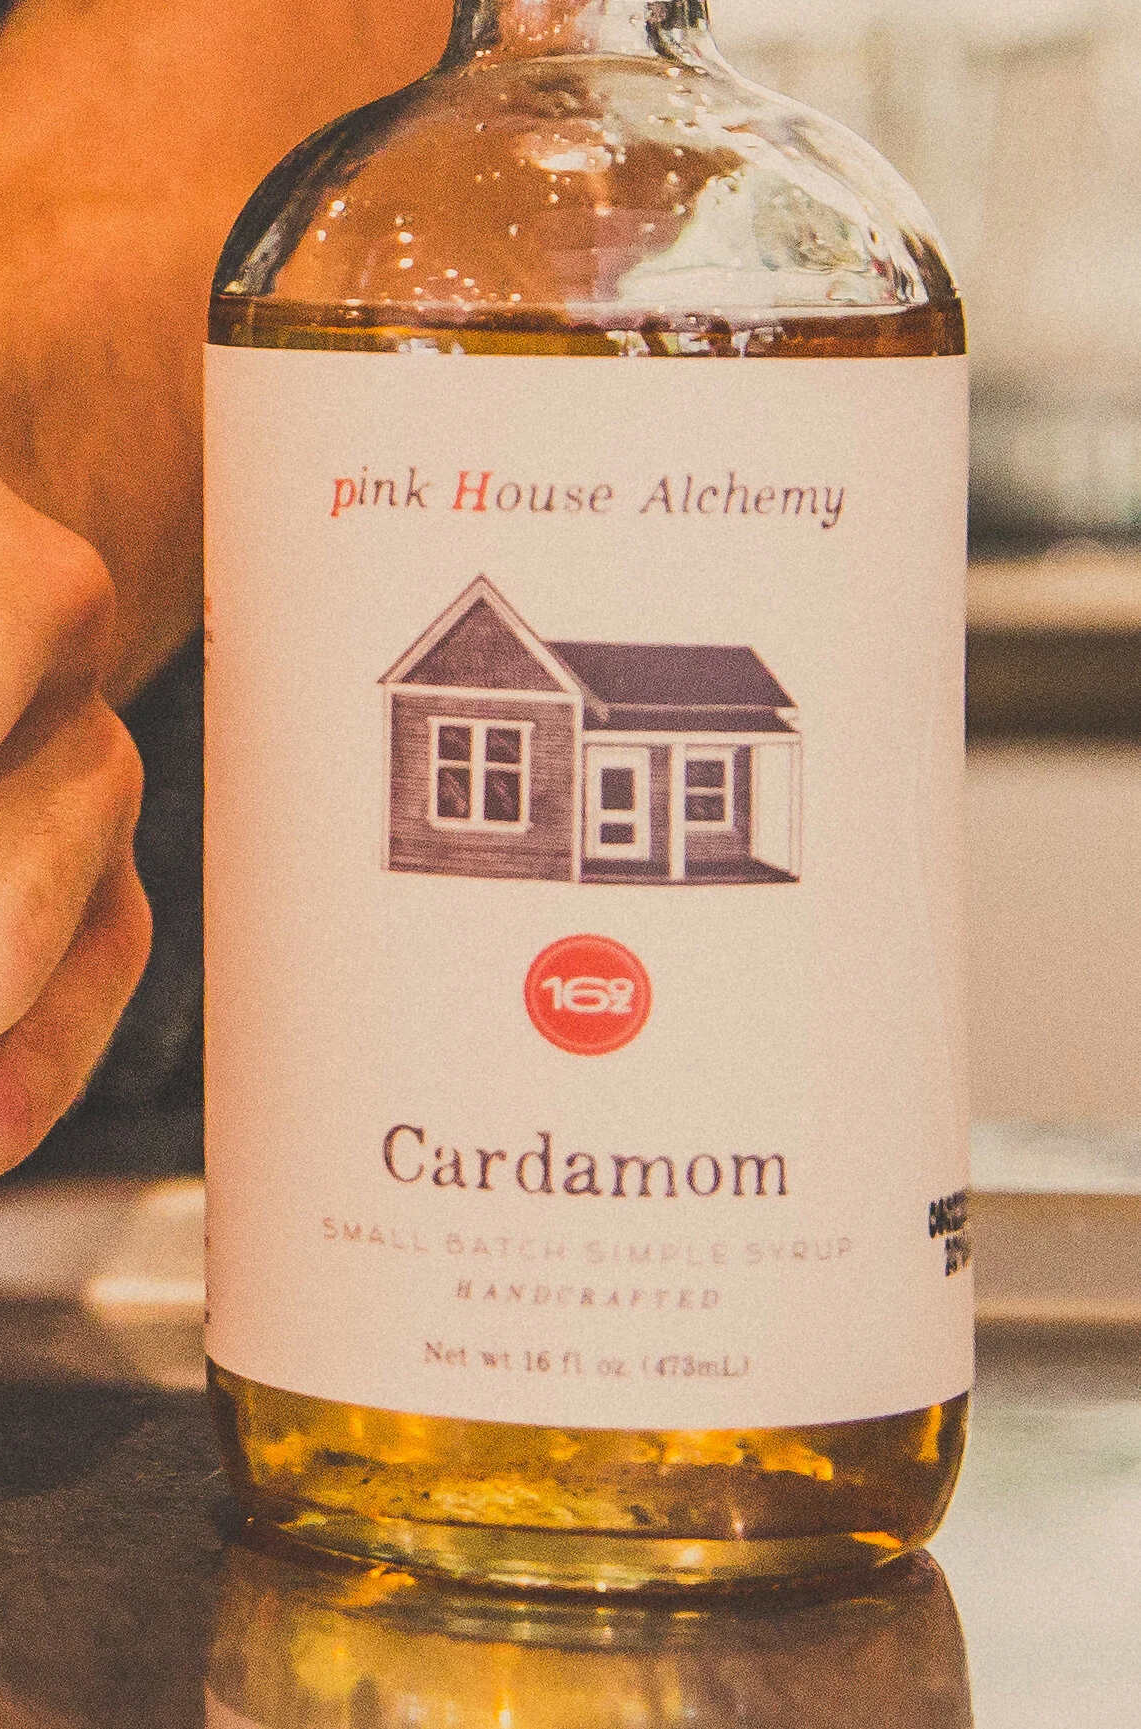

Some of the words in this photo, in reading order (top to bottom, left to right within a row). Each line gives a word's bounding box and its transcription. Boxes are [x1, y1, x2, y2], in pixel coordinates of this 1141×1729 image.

[329, 466, 433, 519] pink
[450, 470, 615, 515] House
[638, 470, 847, 530] Alchemy
[381, 1123, 790, 1200] Cardamom
[321, 1215, 429, 1256] SMALL
[446, 1231, 567, 1264] BATCH
[584, 1239, 729, 1267] SIMPLE
[745, 1235, 853, 1266] SYRUP
[456, 1278, 720, 1311] HANDCRAFTED
[423, 1340, 468, 1368] Net
[480, 1349, 511, 1371] wt
[523, 1349, 552, 1373] 16
[561, 1349, 585, 1375] fl
[596, 1356, 626, 1377] oz
